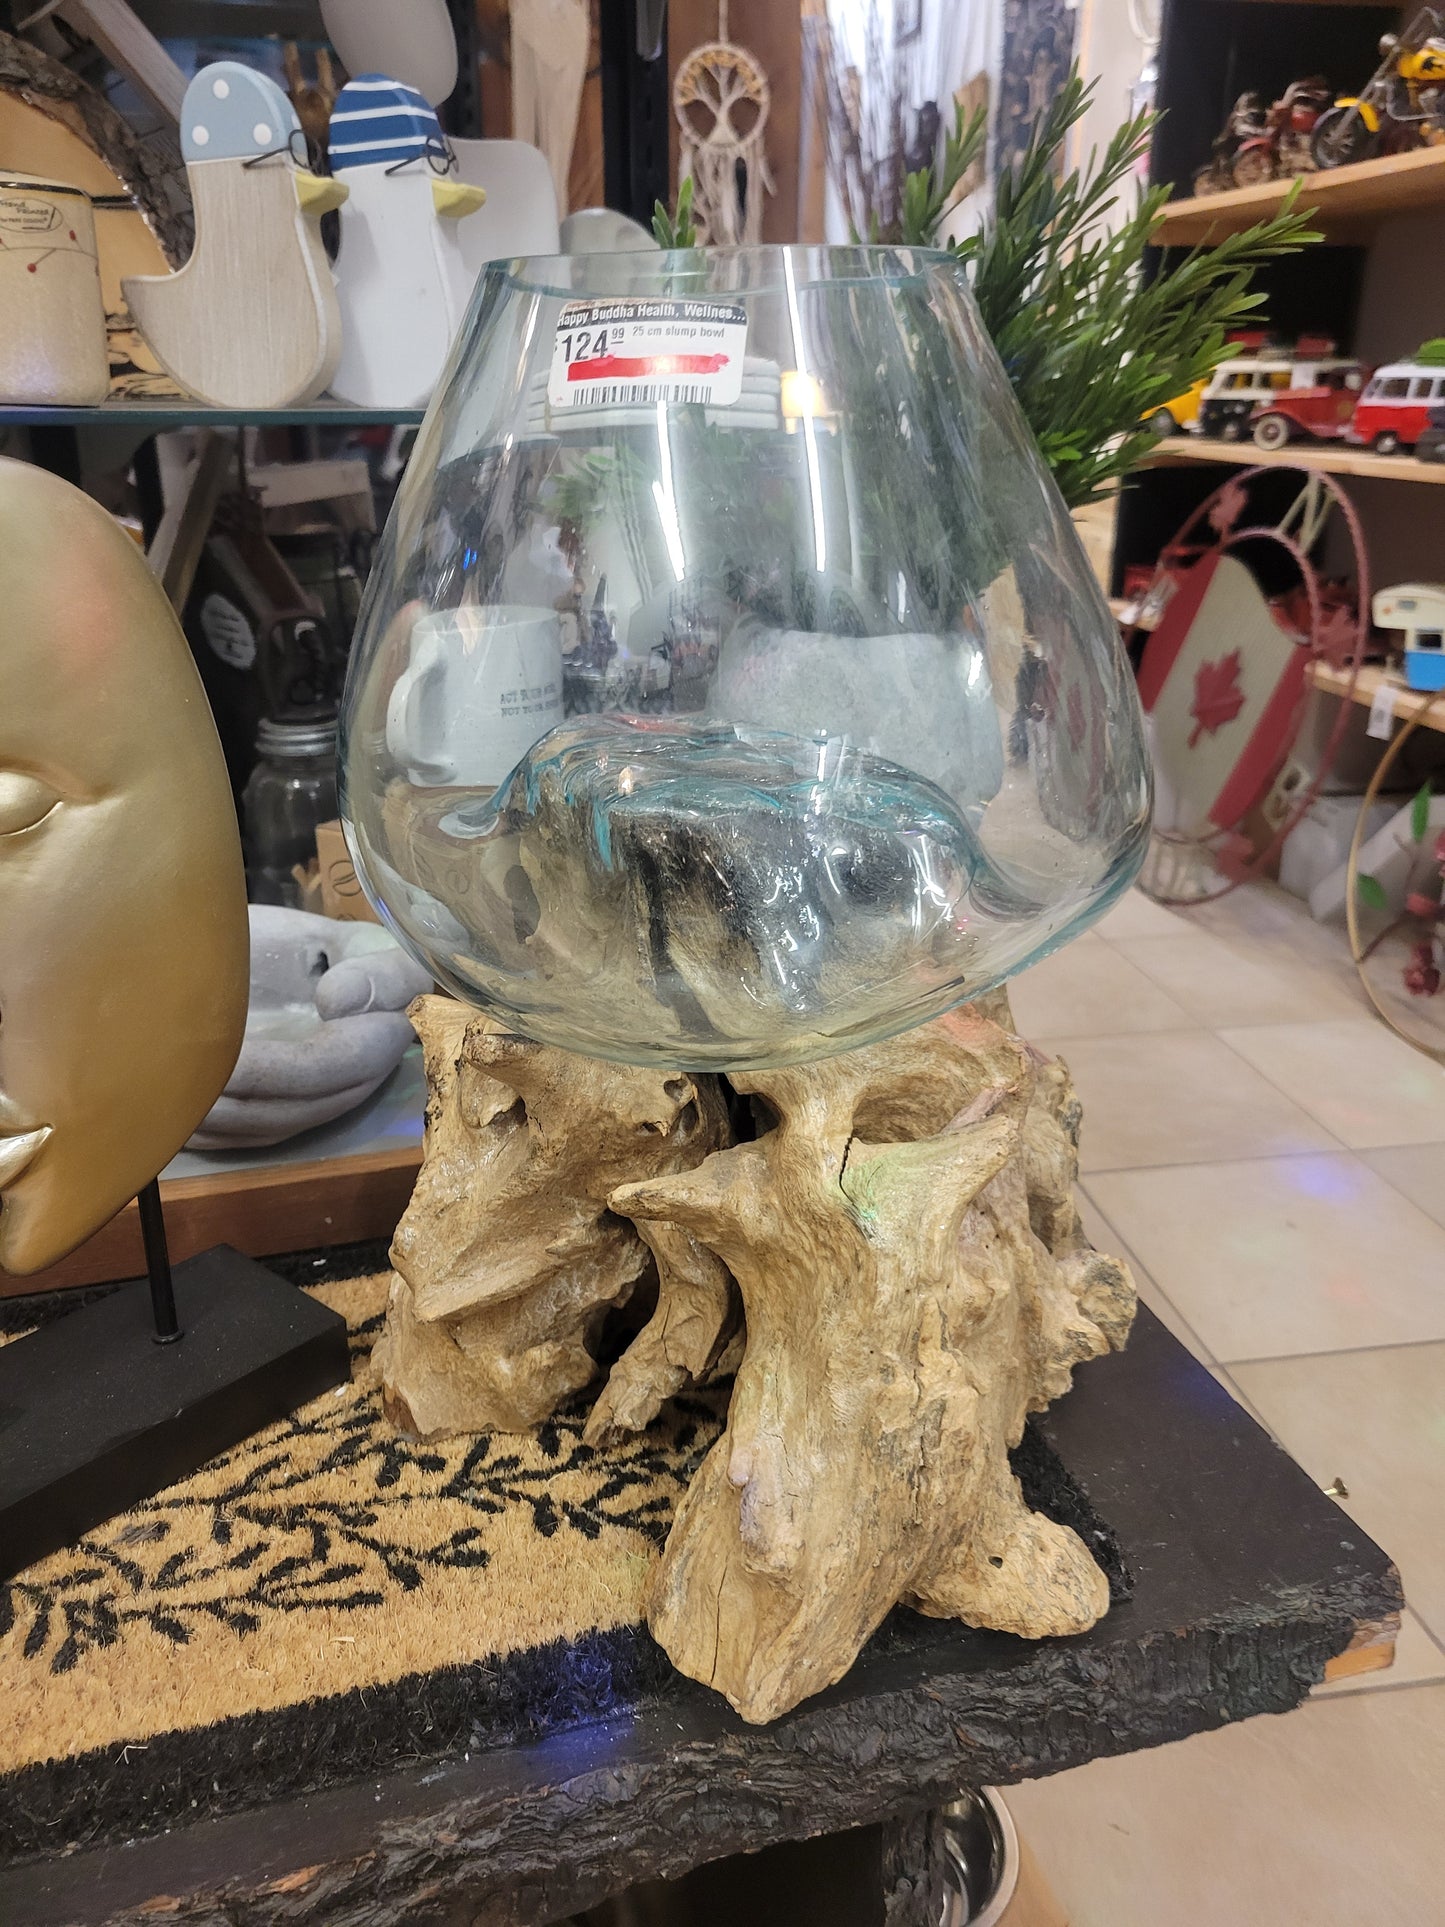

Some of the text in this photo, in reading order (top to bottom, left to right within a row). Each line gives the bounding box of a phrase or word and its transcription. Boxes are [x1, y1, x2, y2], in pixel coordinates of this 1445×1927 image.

[557, 311, 590, 327] Happy
[592, 306, 634, 321] Buddha
[637, 303, 680, 318] Health,
[632, 325, 725, 339] 25 cm slump bowl
